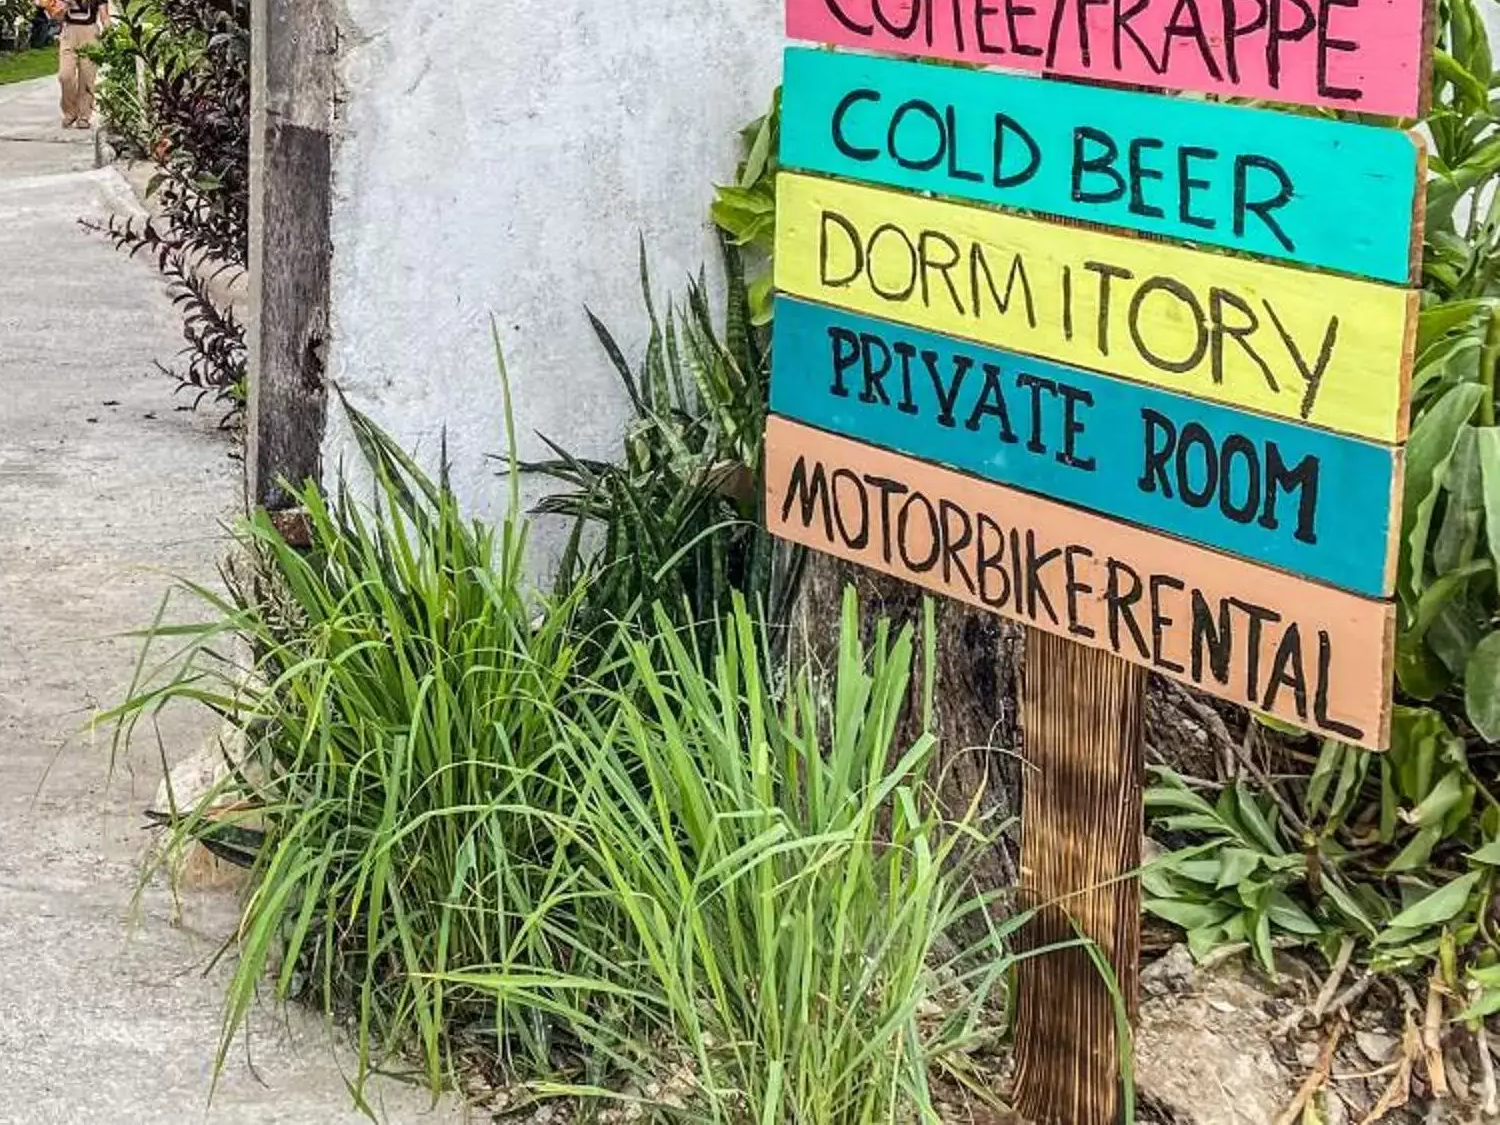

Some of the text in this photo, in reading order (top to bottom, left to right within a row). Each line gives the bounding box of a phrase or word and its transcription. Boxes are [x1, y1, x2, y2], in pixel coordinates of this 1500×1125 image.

[832, 89, 1295, 253] COLD BEER
[819, 209, 1339, 420] DORMITORY
[826, 325, 1320, 546] PRIVATE ROOM
